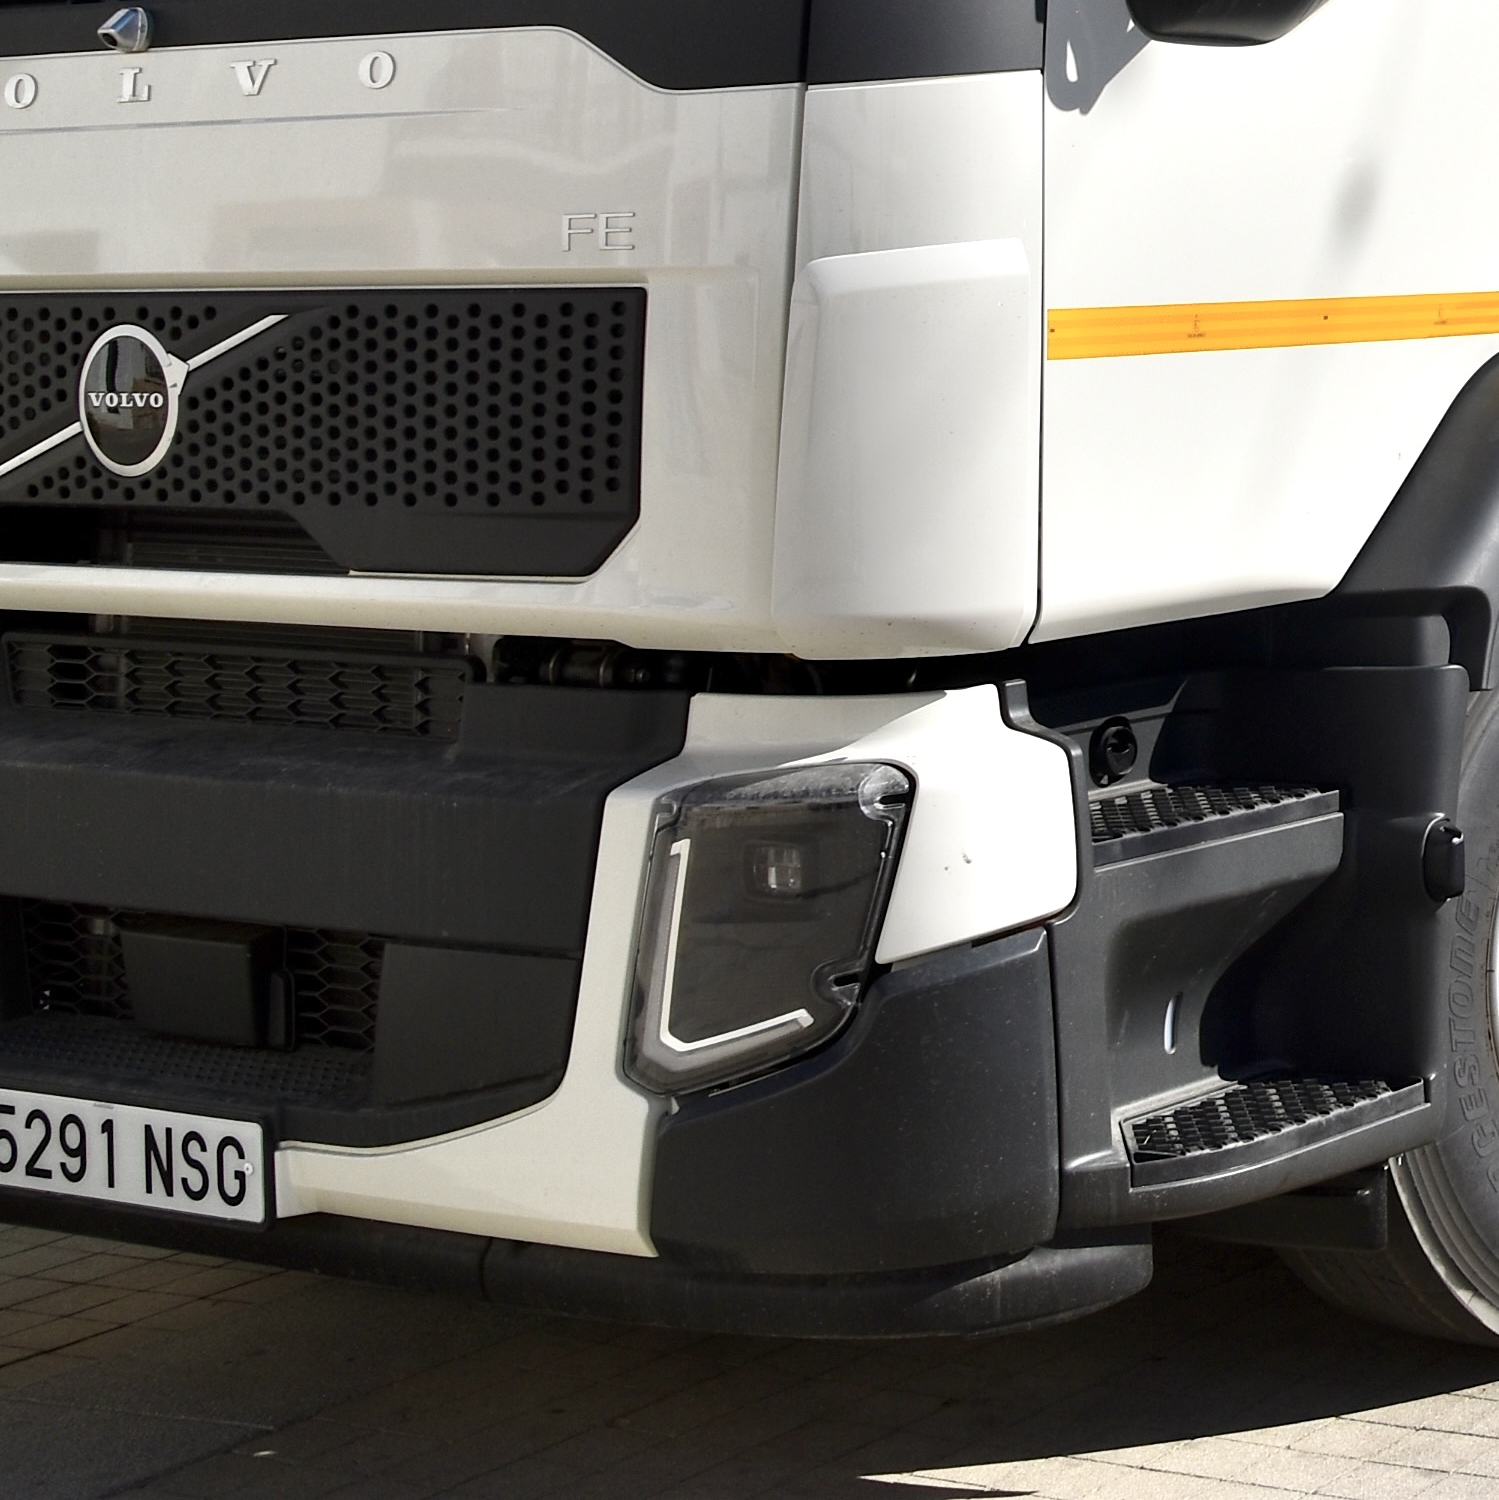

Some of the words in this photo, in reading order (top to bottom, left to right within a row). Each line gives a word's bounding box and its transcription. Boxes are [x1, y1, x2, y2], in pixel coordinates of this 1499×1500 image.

[562, 212, 636, 252] FE
[88, 392, 164, 408] VOLVO
[144, 1124, 247, 1207] NSG
